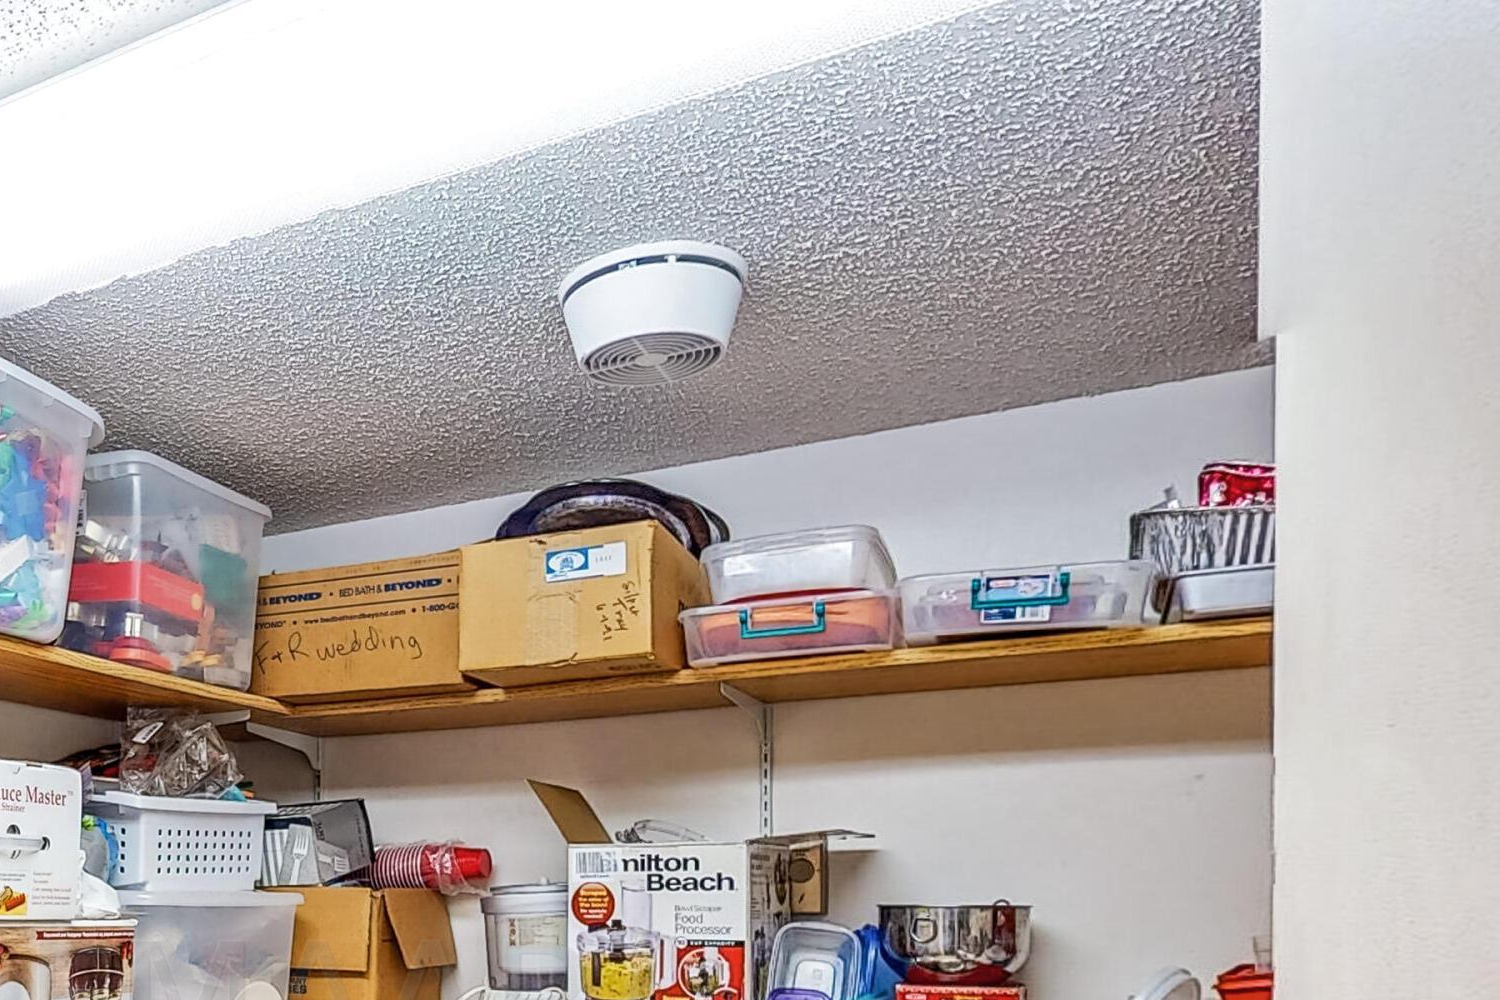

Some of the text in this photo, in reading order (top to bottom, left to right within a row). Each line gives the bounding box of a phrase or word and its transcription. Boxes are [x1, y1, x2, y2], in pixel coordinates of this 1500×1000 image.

[339, 587, 355, 598] BED
[355, 585, 376, 596] BATH
[384, 577, 443, 592] BEYOND
[25, 785, 67, 806] Master
[647, 872, 735, 892] Beach
[674, 912, 703, 924] Food
[674, 924, 732, 936] Processor
